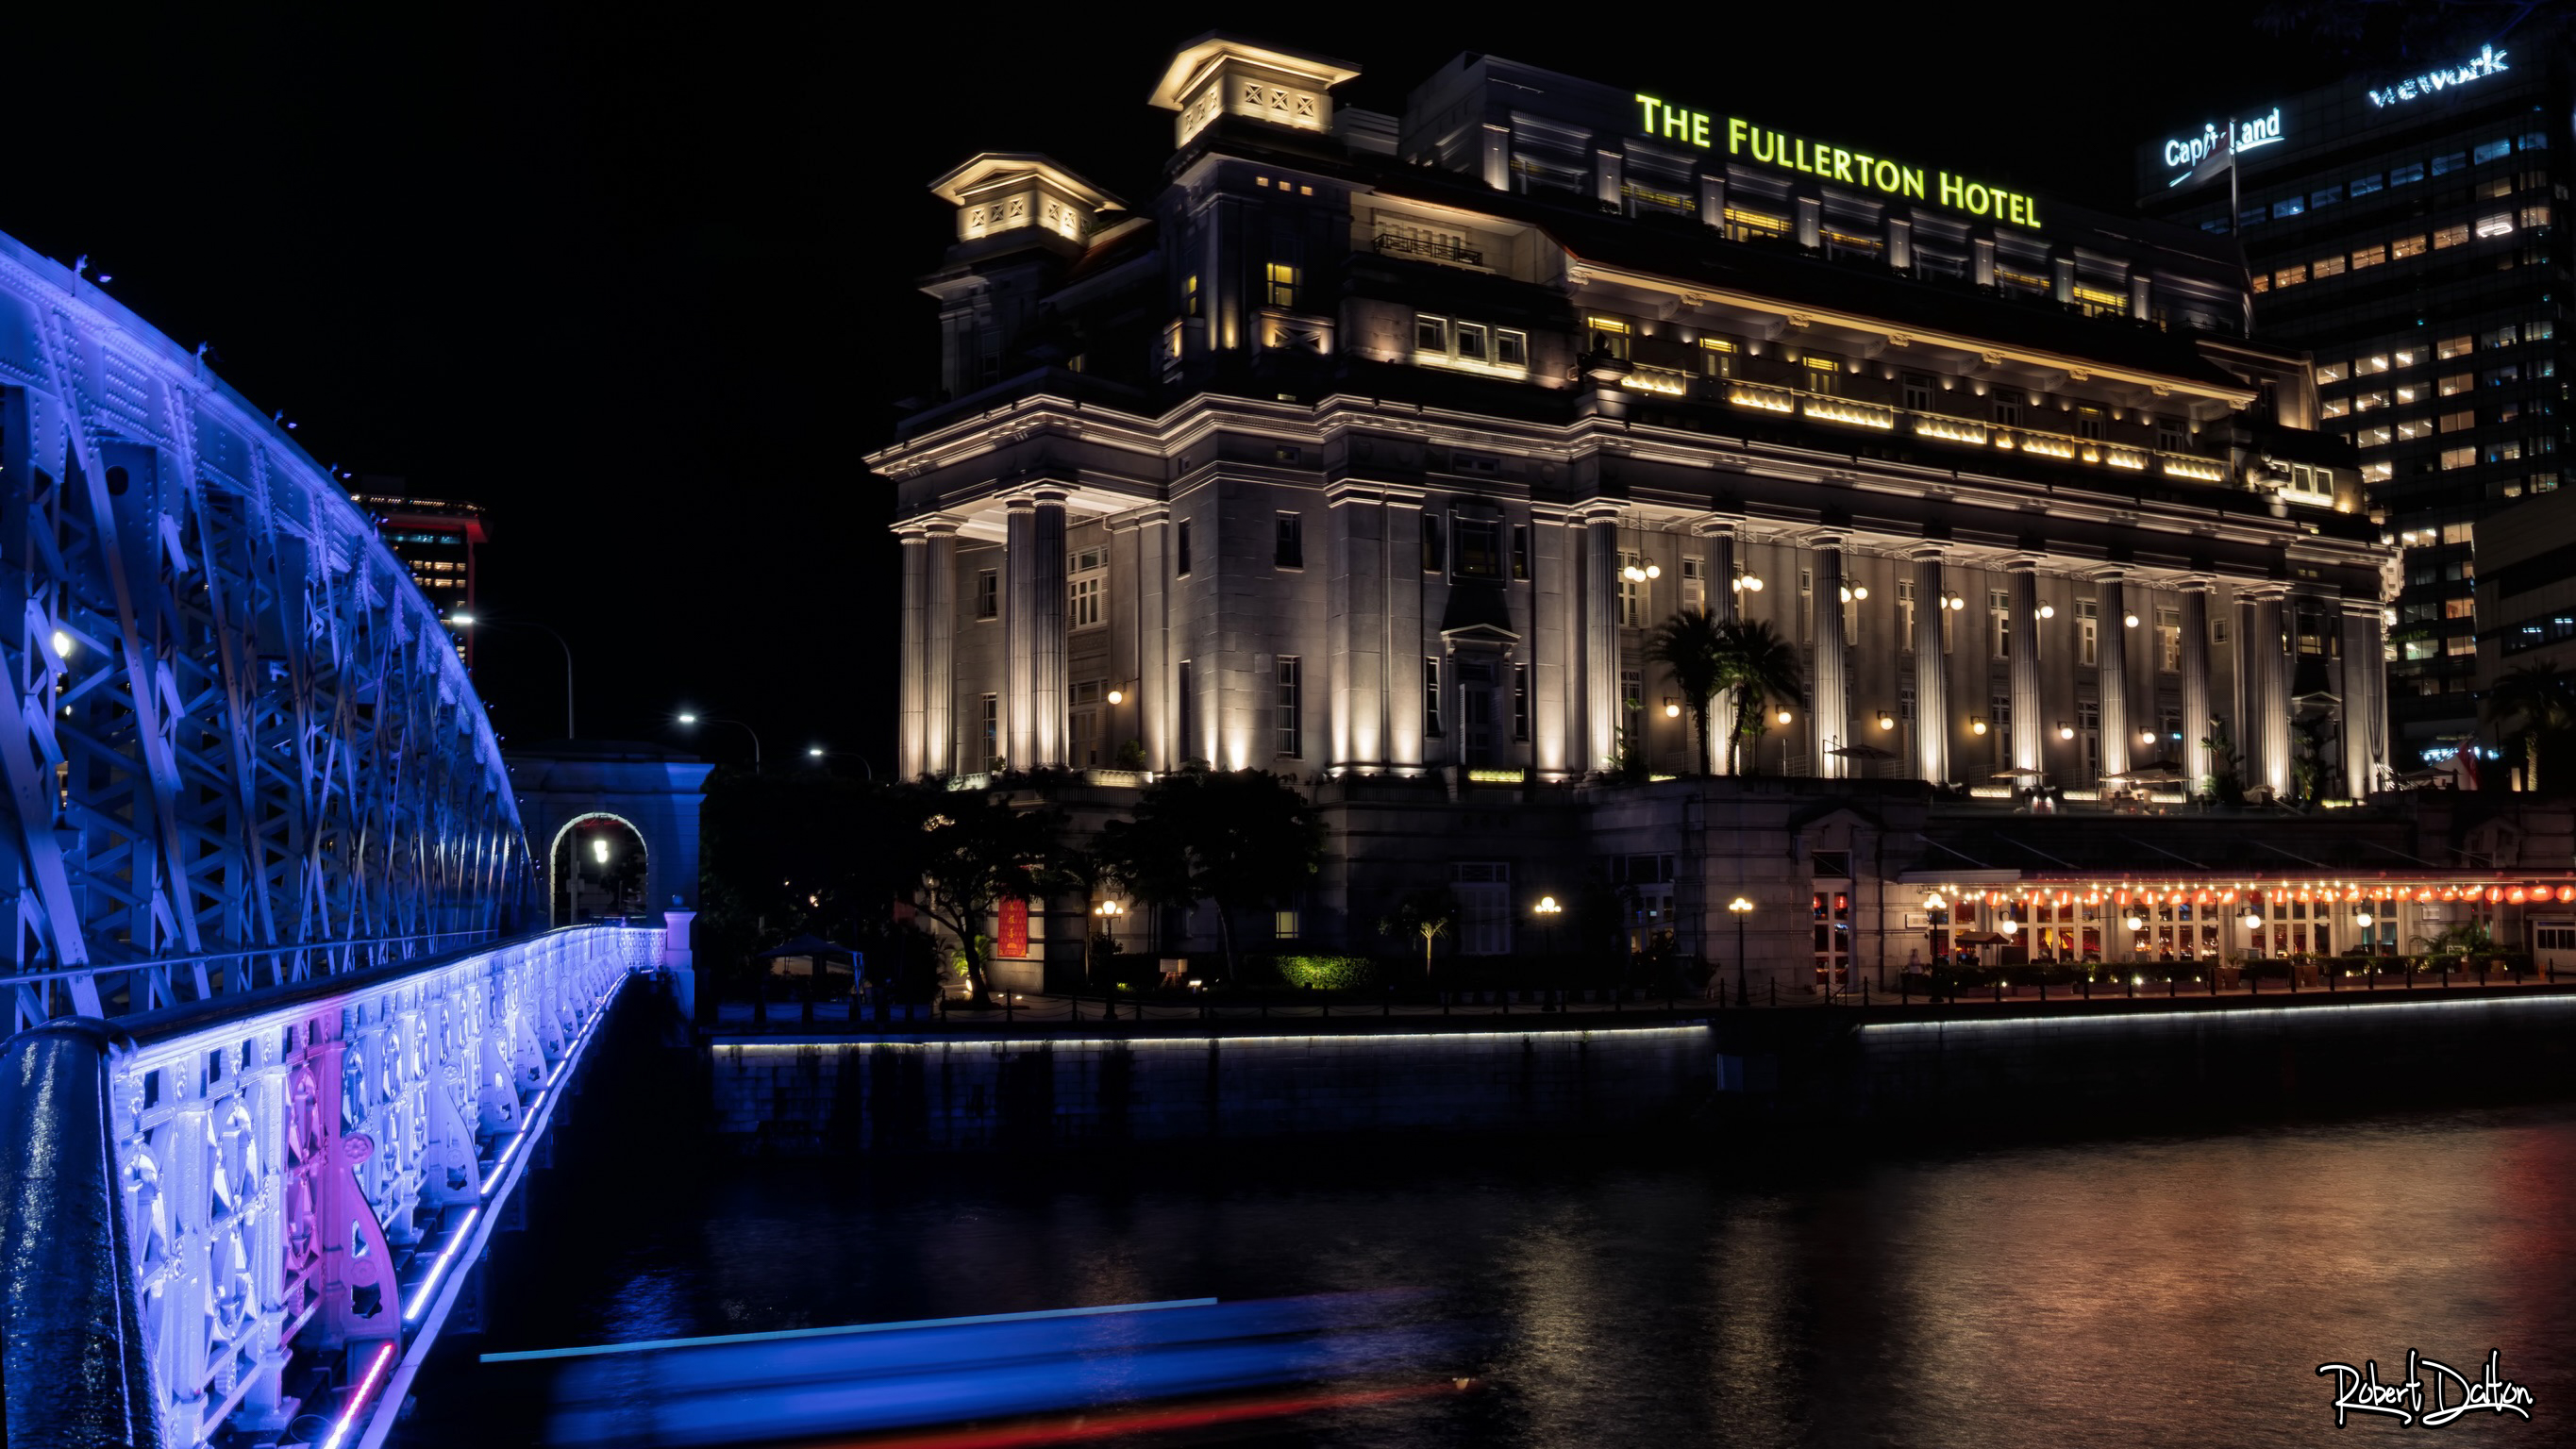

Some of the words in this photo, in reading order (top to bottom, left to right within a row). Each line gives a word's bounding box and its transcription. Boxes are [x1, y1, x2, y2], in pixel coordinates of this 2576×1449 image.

[1636, 94, 1710, 147] THE
[1730, 119, 1924, 199] FULLERTON
[1940, 173, 2040, 227] HOTEL
[2166, 108, 2282, 166] CapitLand
